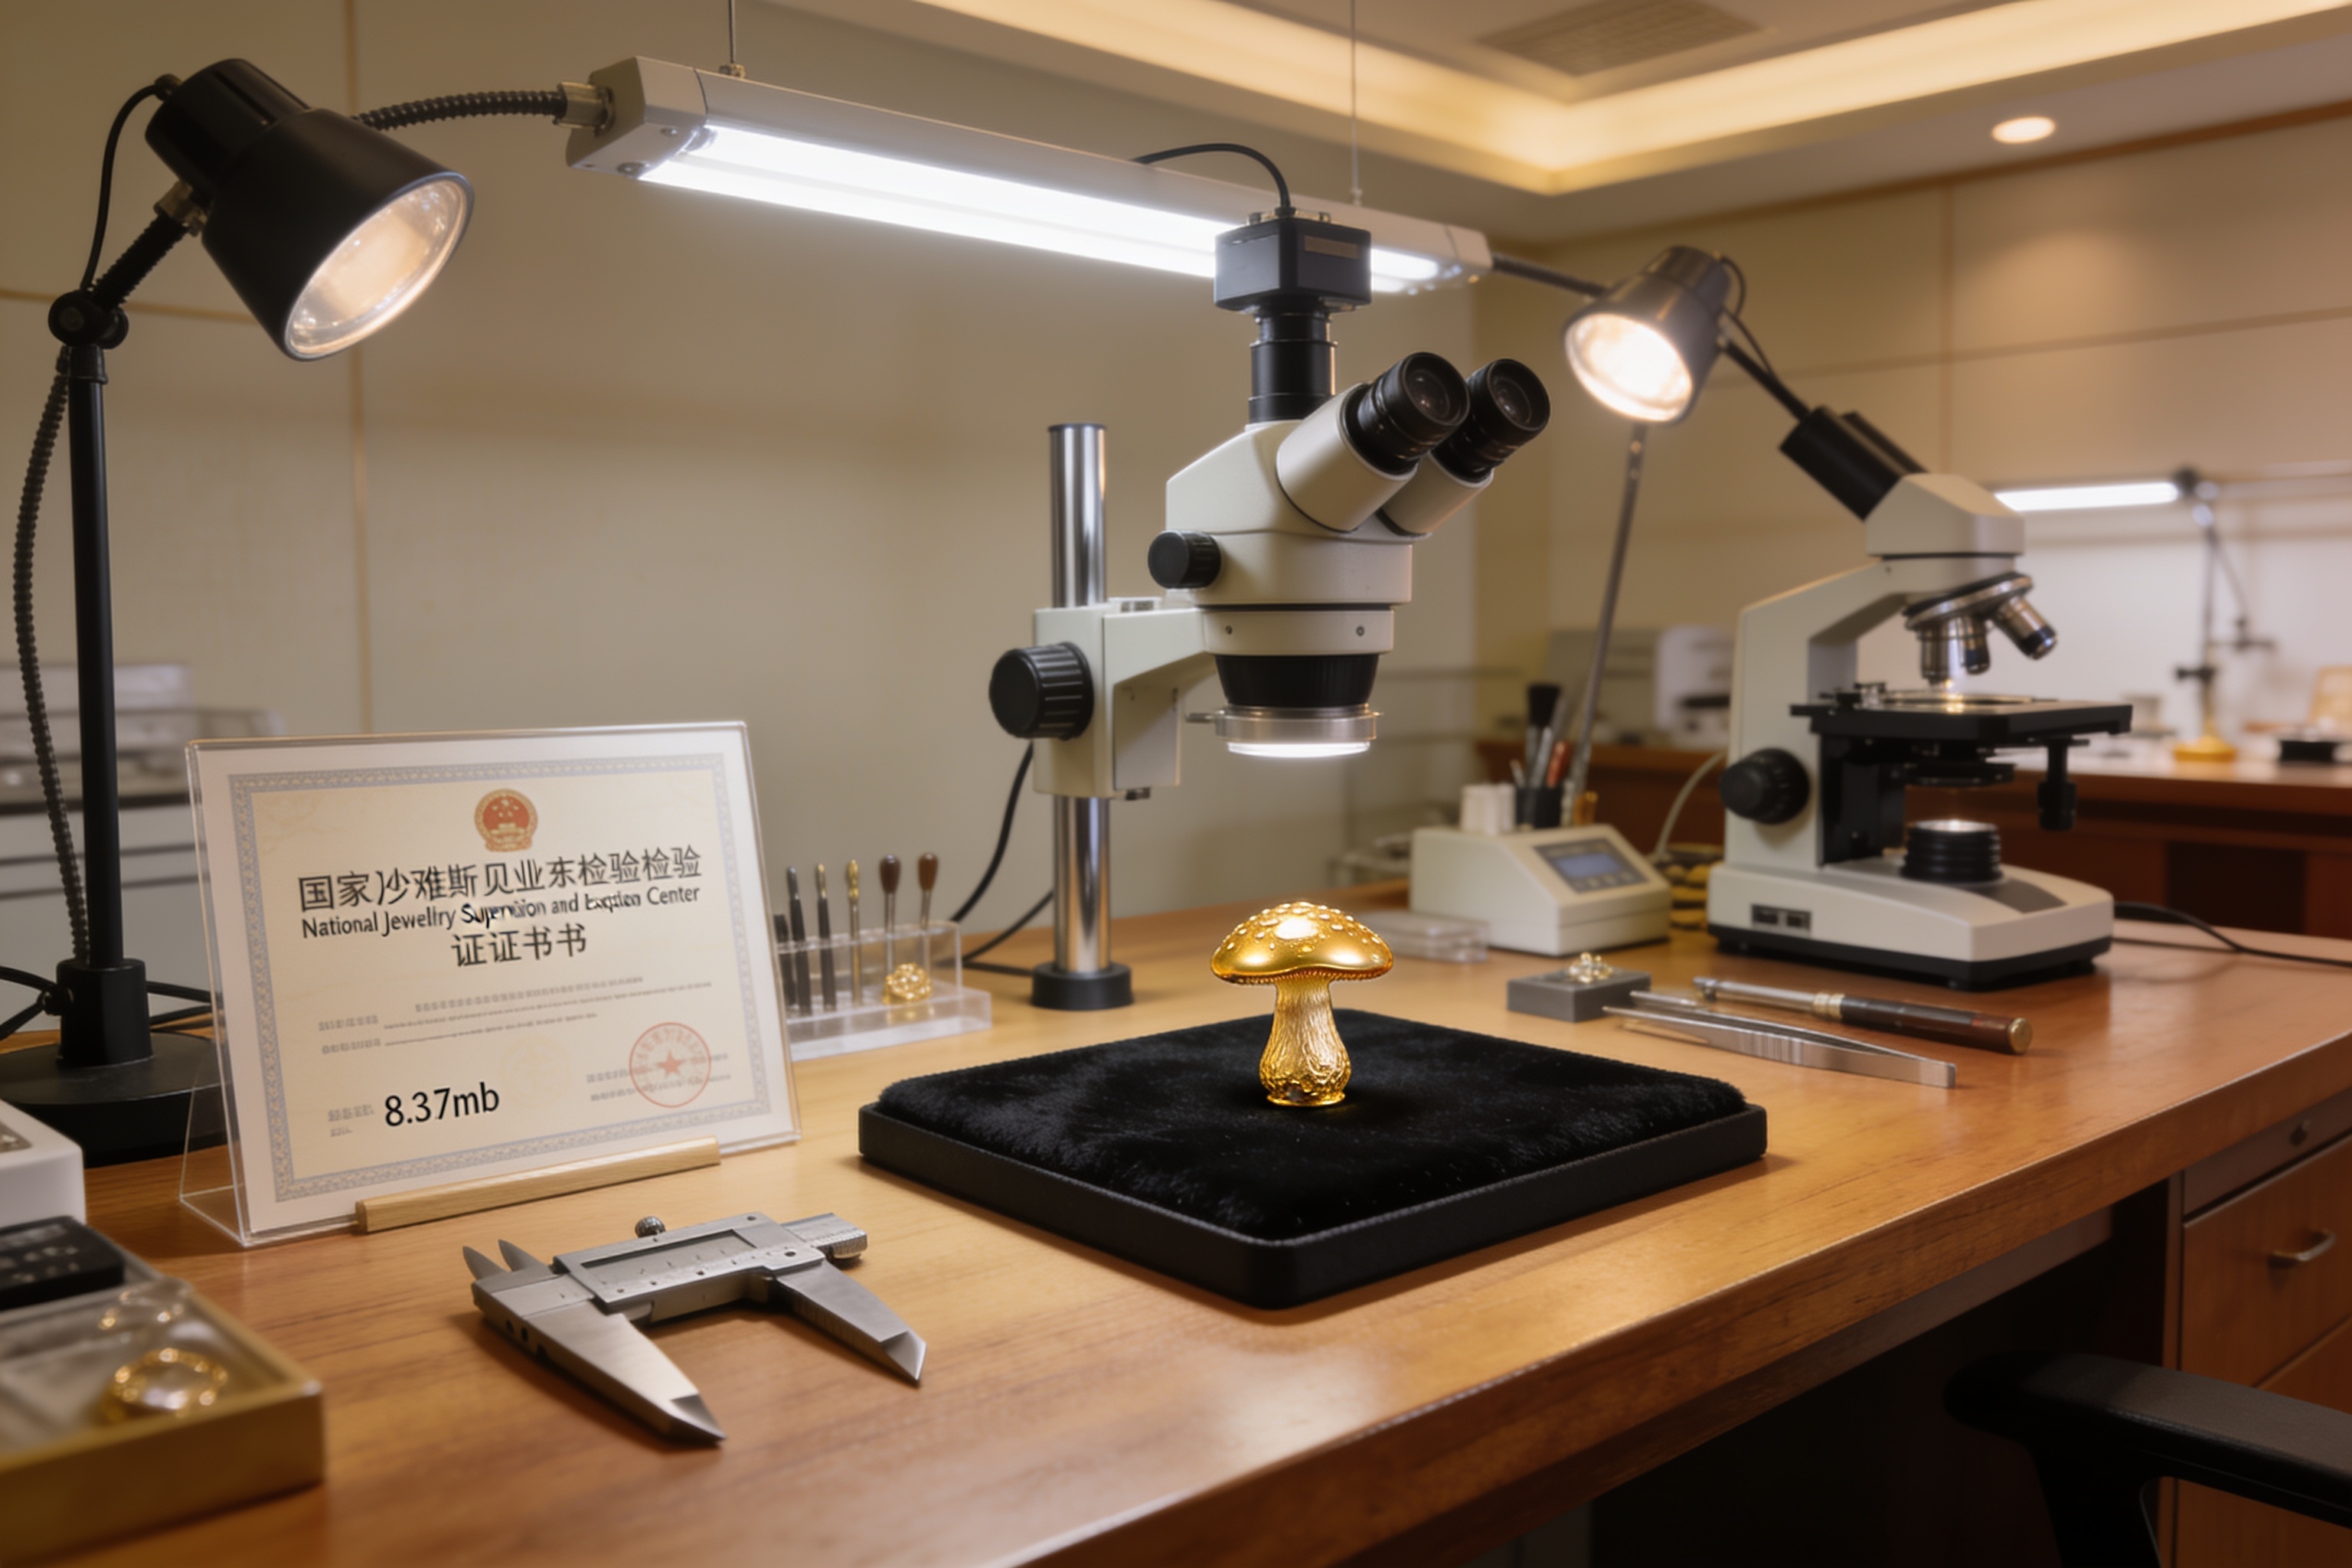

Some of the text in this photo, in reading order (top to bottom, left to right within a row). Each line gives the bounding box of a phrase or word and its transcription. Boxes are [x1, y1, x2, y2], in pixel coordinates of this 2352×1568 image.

[302, 911, 378, 939] National
[551, 892, 579, 914] and
[647, 886, 700, 906] Center
[451, 922, 586, 968] 证证书书
[385, 1081, 499, 1127] 8.37mb
